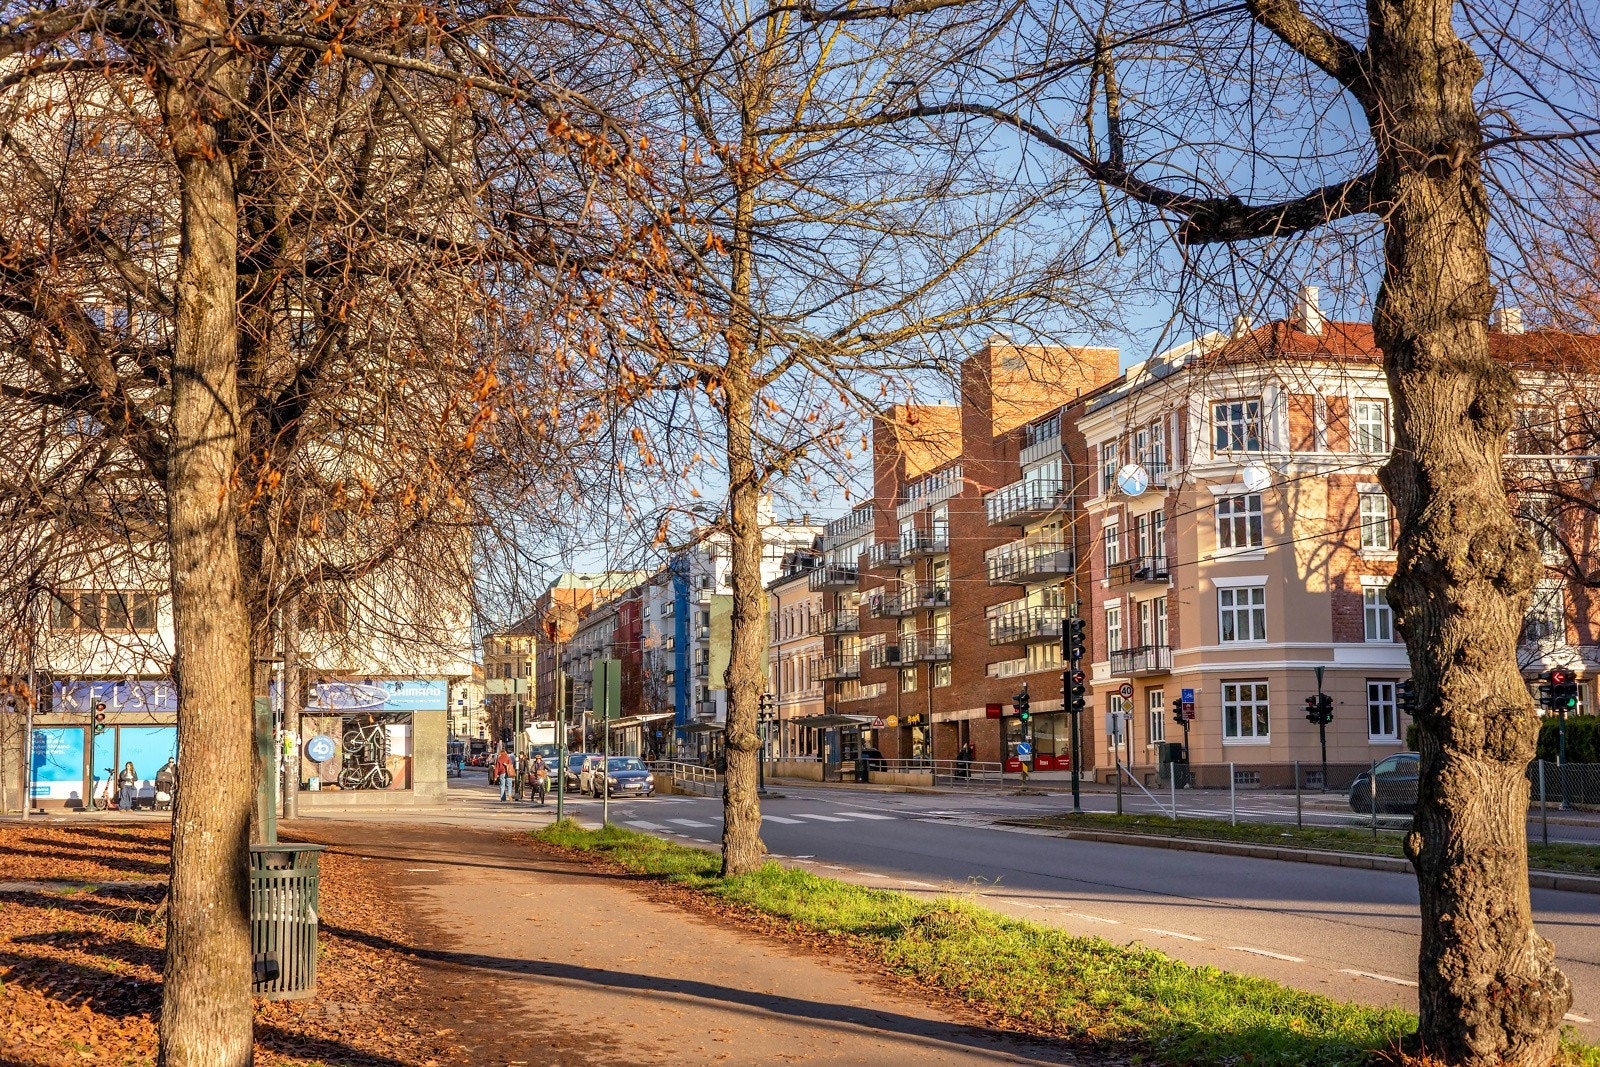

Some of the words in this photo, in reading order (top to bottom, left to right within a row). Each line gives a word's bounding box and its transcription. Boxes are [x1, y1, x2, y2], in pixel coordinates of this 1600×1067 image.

[390, 688, 440, 696] SHIMANO
[1121, 686, 1132, 695] 40
[312, 741, 329, 755] 40
